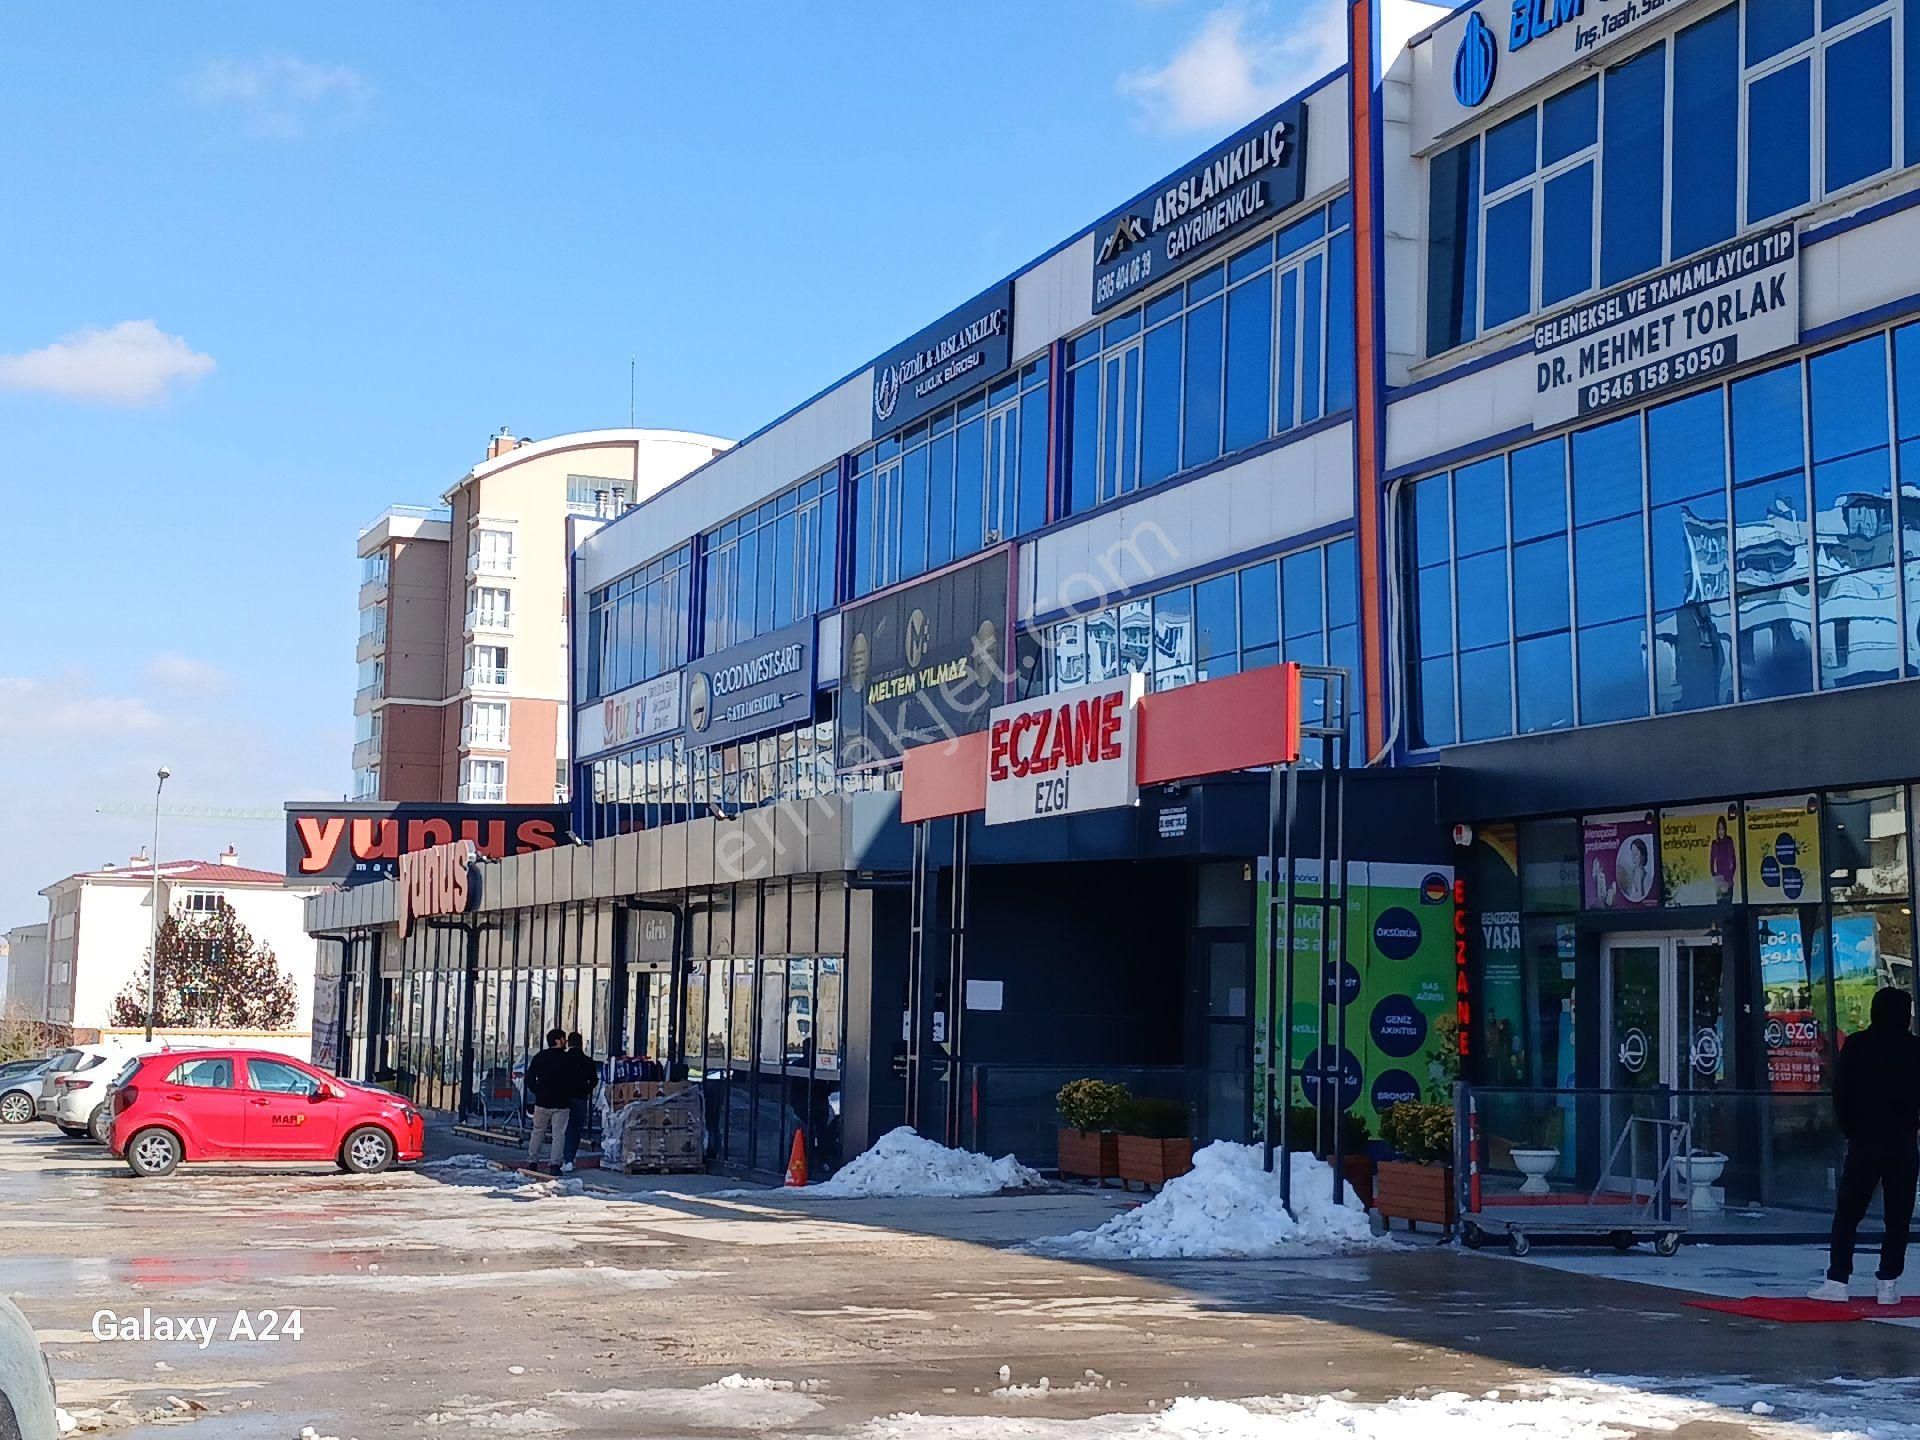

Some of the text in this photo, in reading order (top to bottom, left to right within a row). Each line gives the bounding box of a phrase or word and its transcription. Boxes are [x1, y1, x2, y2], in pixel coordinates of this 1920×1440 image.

[1152, 121, 1286, 233] ARSLANKILIÇ
[1166, 180, 1265, 260] GAYRİMENKUL
[1534, 231, 1791, 349] GELENEKSEL VE TAMAMLAYICI TIP
[1537, 272, 1786, 393] DR. MEHMET TORLAK
[1588, 343, 1725, 408] 0546 158 5050
[868, 673, 917, 704] MELTEM
[919, 656, 969, 689] YILMAZ
[991, 690, 1124, 782] ECZANE
[1034, 770, 1070, 815] EZGİ
[295, 817, 556, 874] yunus
[399, 840, 472, 940] yunus
